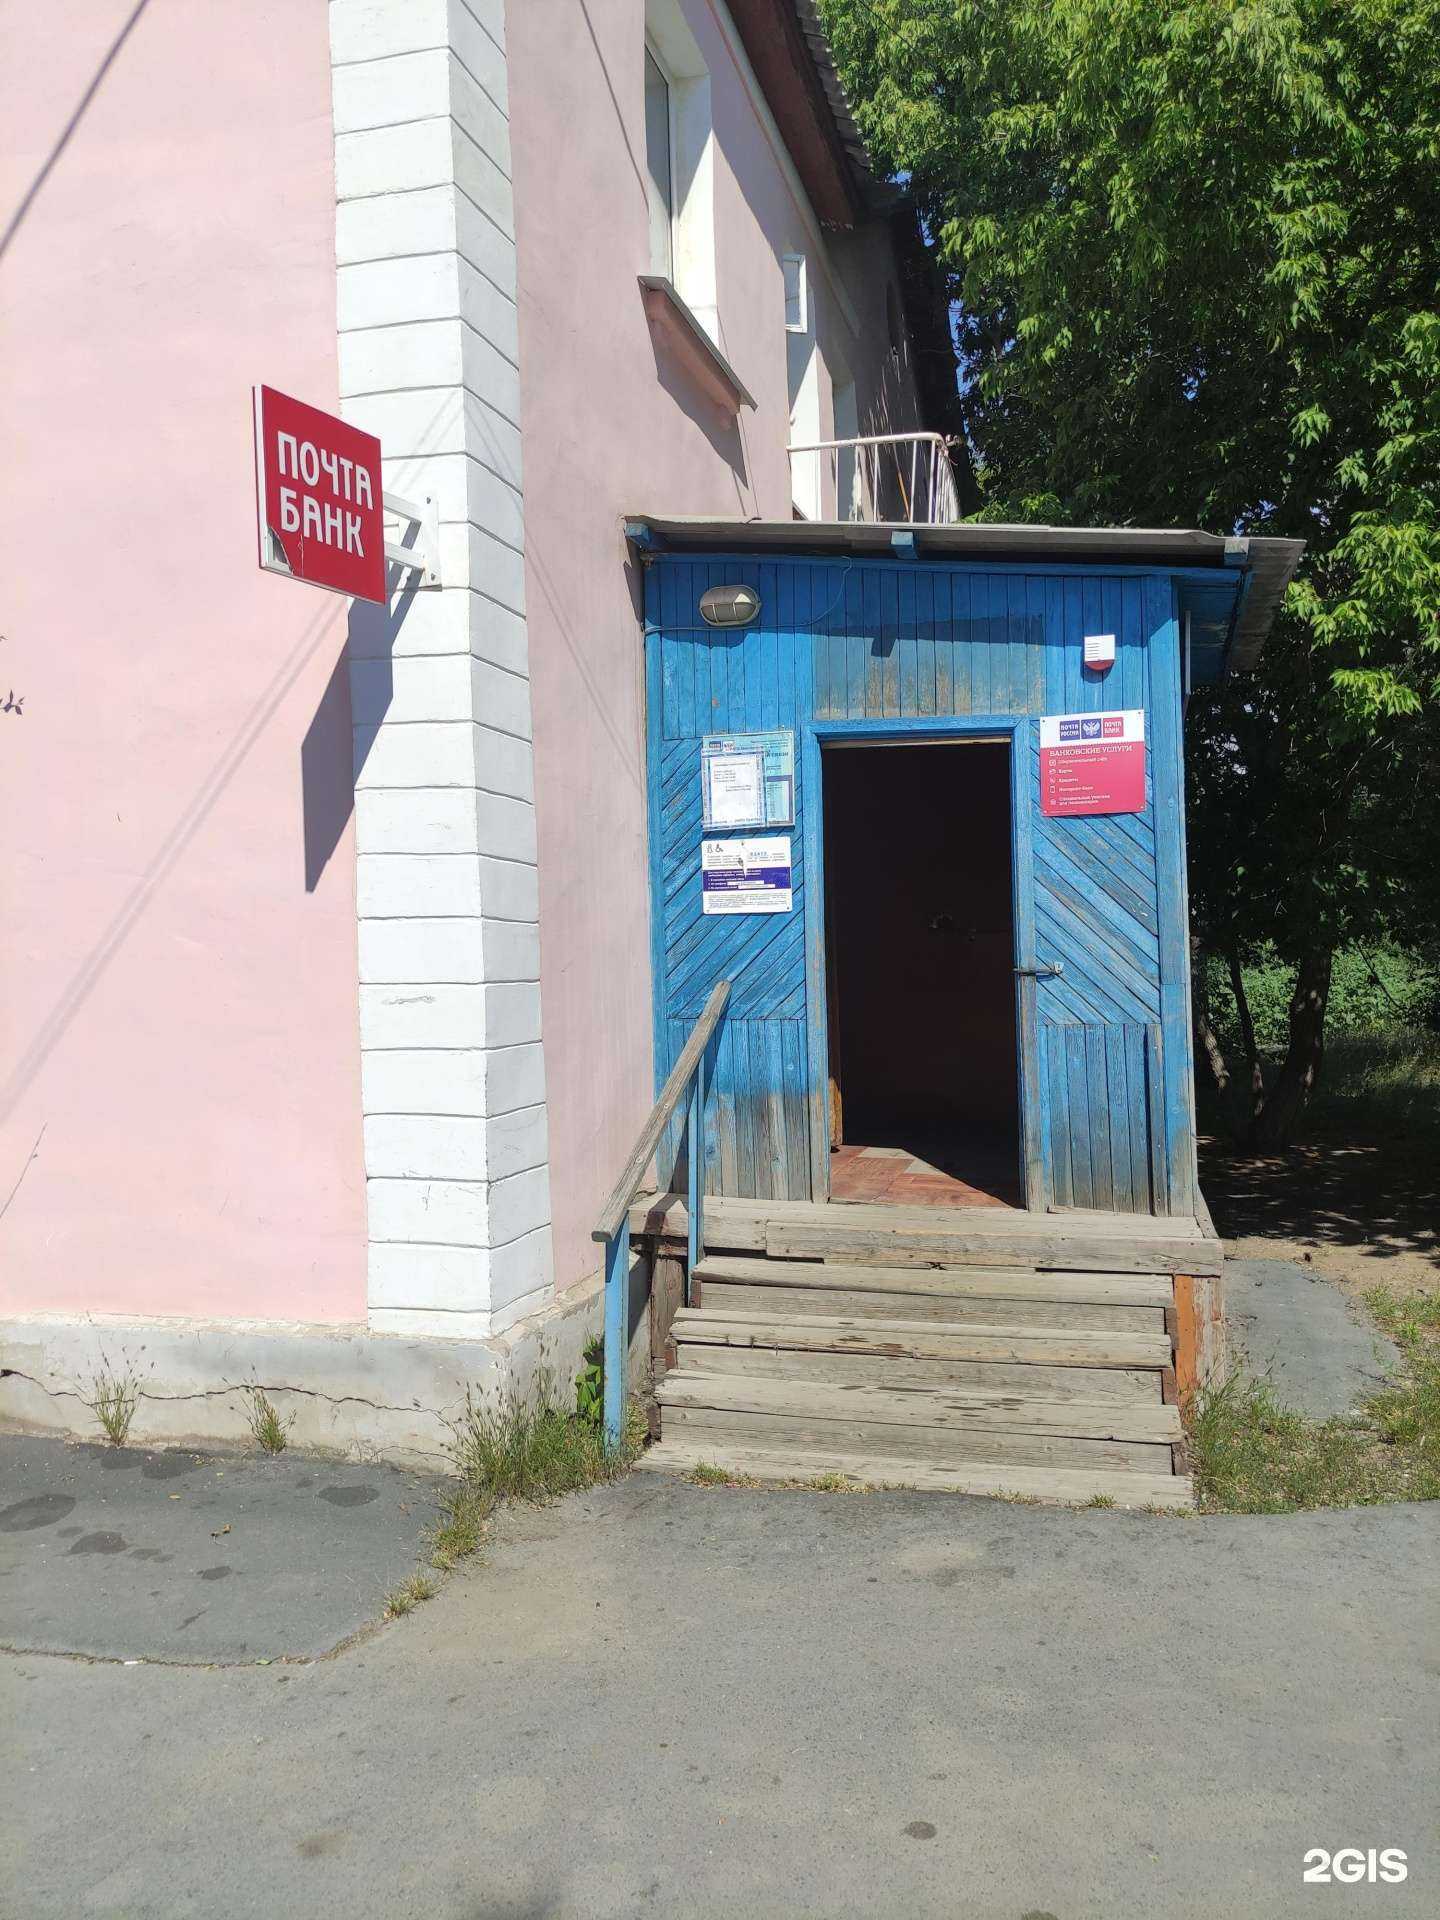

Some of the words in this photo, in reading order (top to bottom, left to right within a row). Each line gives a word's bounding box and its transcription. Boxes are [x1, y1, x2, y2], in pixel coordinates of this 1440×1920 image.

[277, 430, 374, 511] ПОЧТА
[279, 486, 365, 558] БАНК
[1060, 723, 1079, 731] ПОЧТА
[1104, 720, 1122, 728] ПОЧТА
[1049, 748, 1101, 757] БАНКОВСКИЕ
[1102, 745, 1133, 753] УСЛУГИ
